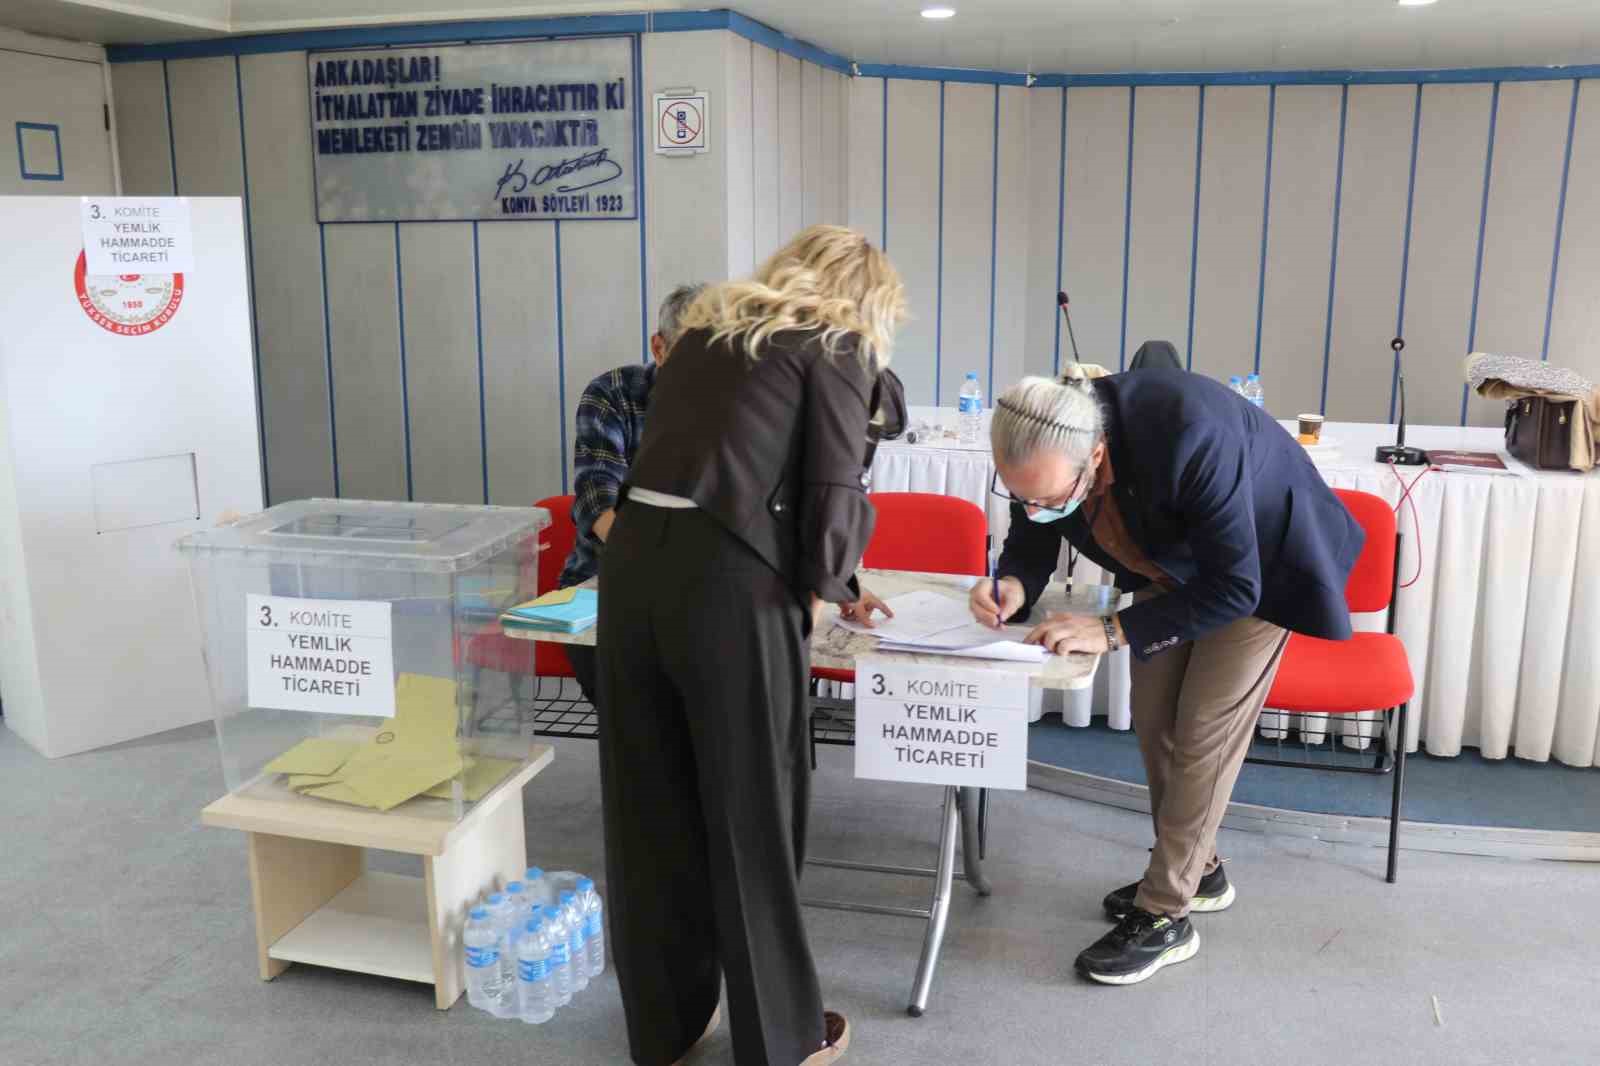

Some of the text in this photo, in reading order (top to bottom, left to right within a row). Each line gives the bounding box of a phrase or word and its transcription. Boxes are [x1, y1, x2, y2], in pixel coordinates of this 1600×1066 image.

[315, 56, 440, 89] ARKADAŞLAR!
[315, 77, 625, 121] İTHALATTAN ZİYADE İHRACATTIR Kİ
[318, 120, 411, 155] MEMLEKETİ
[416, 119, 482, 151] ZENGİN
[91, 205, 160, 219] 3. KOMİTE
[502, 192, 623, 214] KONYA SÖYLEVİ 1923
[101, 238, 175, 248] HAMMADDE
[111, 252, 168, 263] TİCARETİ
[260, 605, 352, 629] 3. KOMİTE
[271, 655, 372, 675] HAMMADDE
[282, 674, 361, 697] TİCARETİ
[871, 673, 979, 699] 3. KOMİTE
[882, 723, 998, 747] HAMMADDE
[895, 744, 985, 768] TİCARETİ
